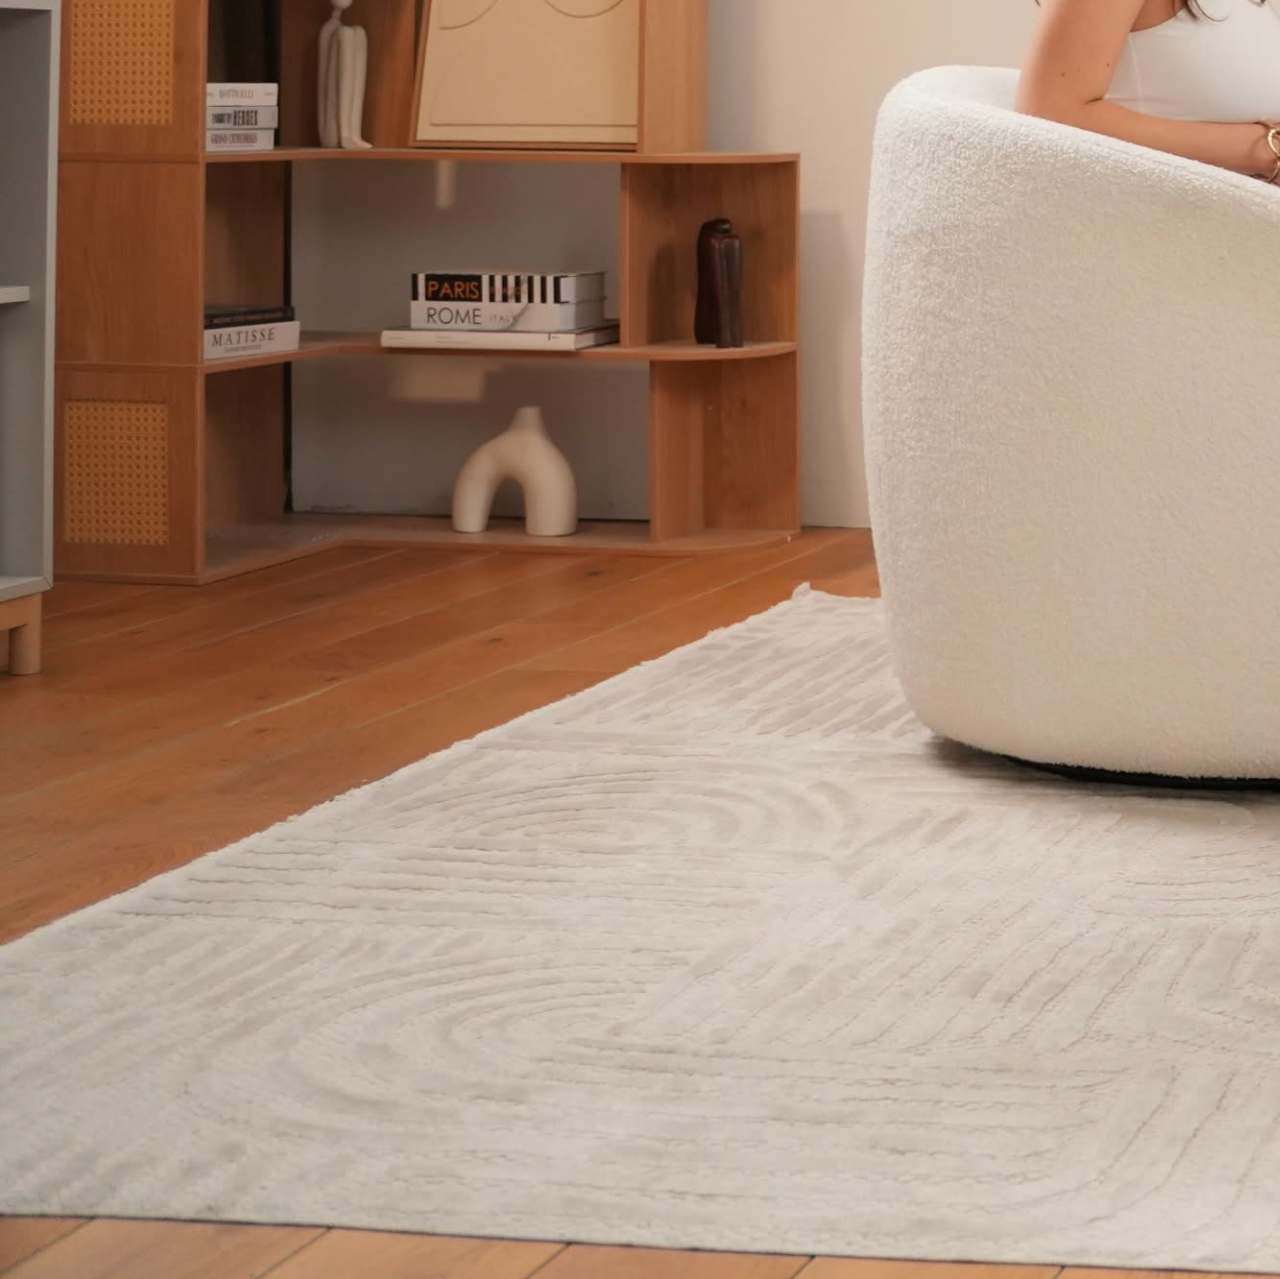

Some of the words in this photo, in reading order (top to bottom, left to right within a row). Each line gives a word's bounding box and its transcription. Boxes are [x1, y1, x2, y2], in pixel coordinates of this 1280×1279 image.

[427, 280, 481, 299] PARIS
[426, 307, 482, 325] ROME
[211, 327, 276, 347] MATISSE
